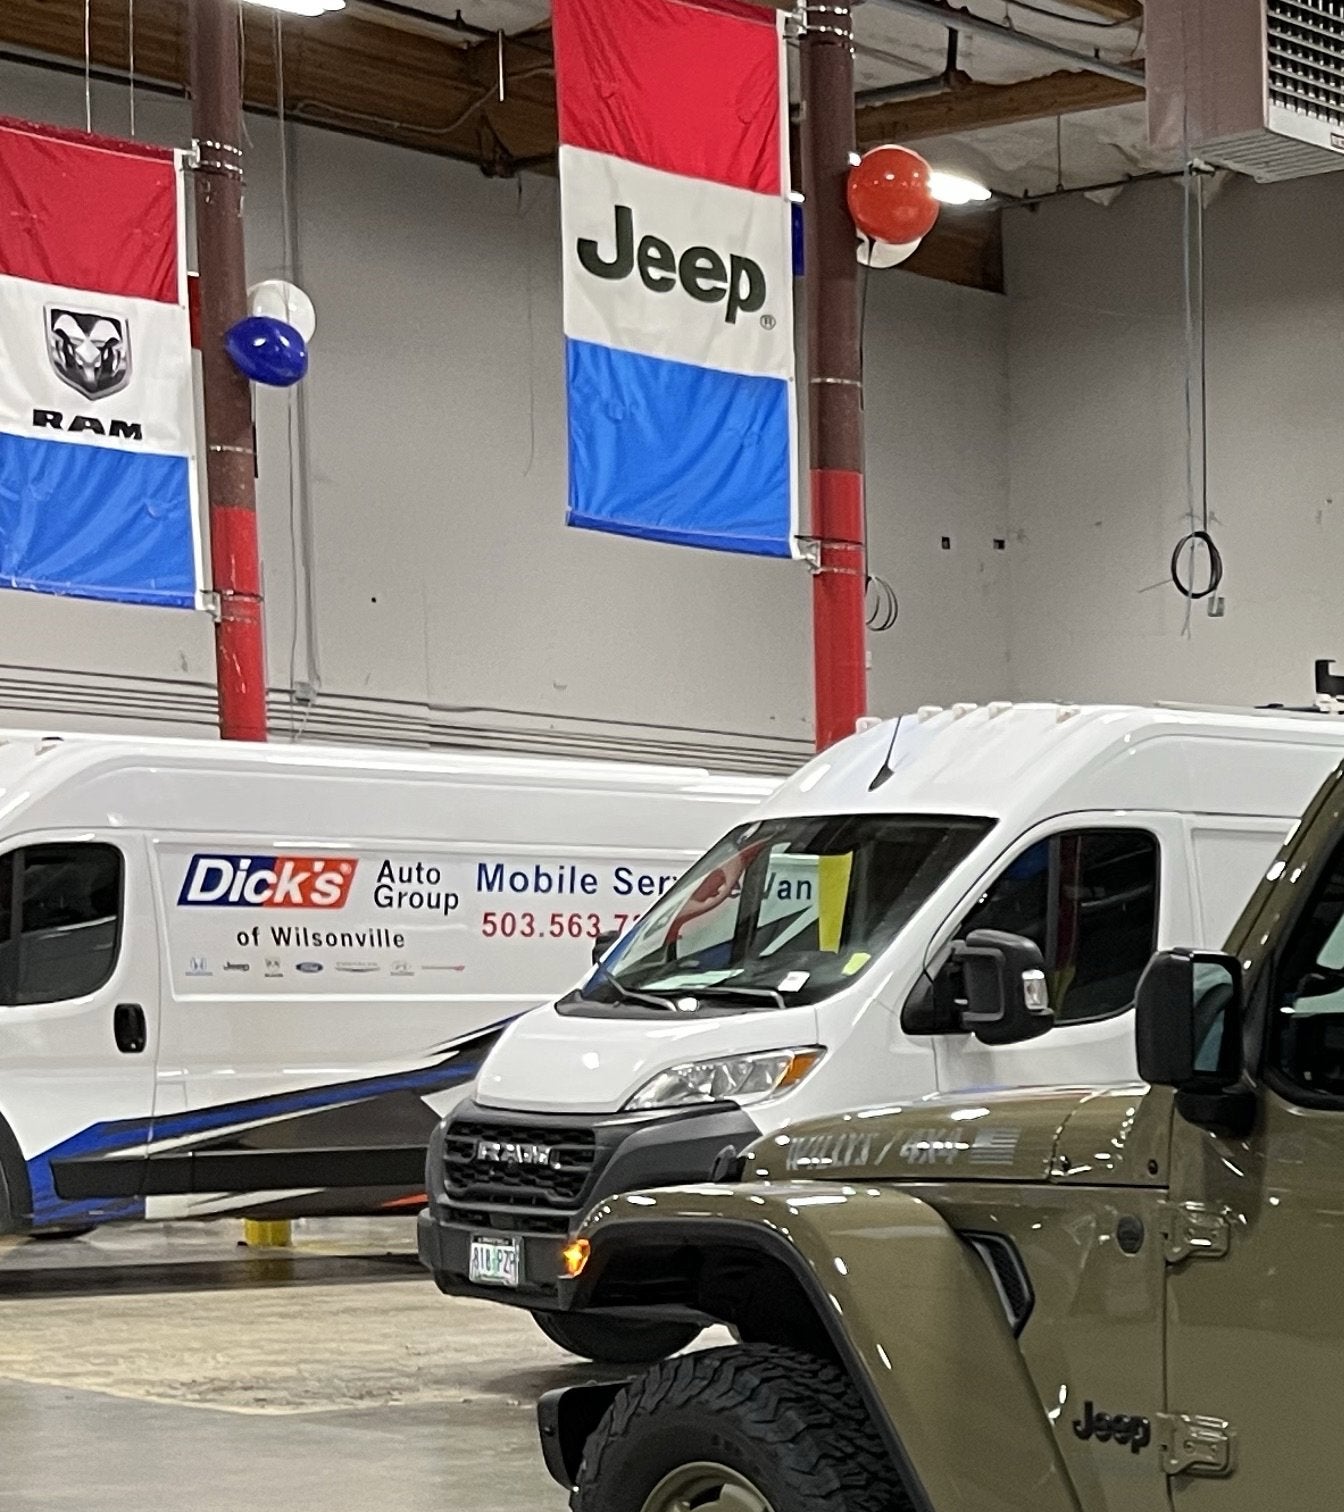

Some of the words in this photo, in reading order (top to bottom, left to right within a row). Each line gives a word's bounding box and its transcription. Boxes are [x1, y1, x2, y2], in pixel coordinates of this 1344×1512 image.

[577, 204, 767, 325] Jeep
[32, 408, 143, 441] RAM
[186, 857, 344, 906] Dick's
[376, 859, 442, 886] Auto
[476, 863, 599, 896] Mobile
[373, 884, 460, 916] Group
[236, 926, 261, 947] of
[270, 926, 406, 948] Wilsonville
[477, 1141, 551, 1166] RAM
[1072, 1400, 1151, 1456] Jeep
